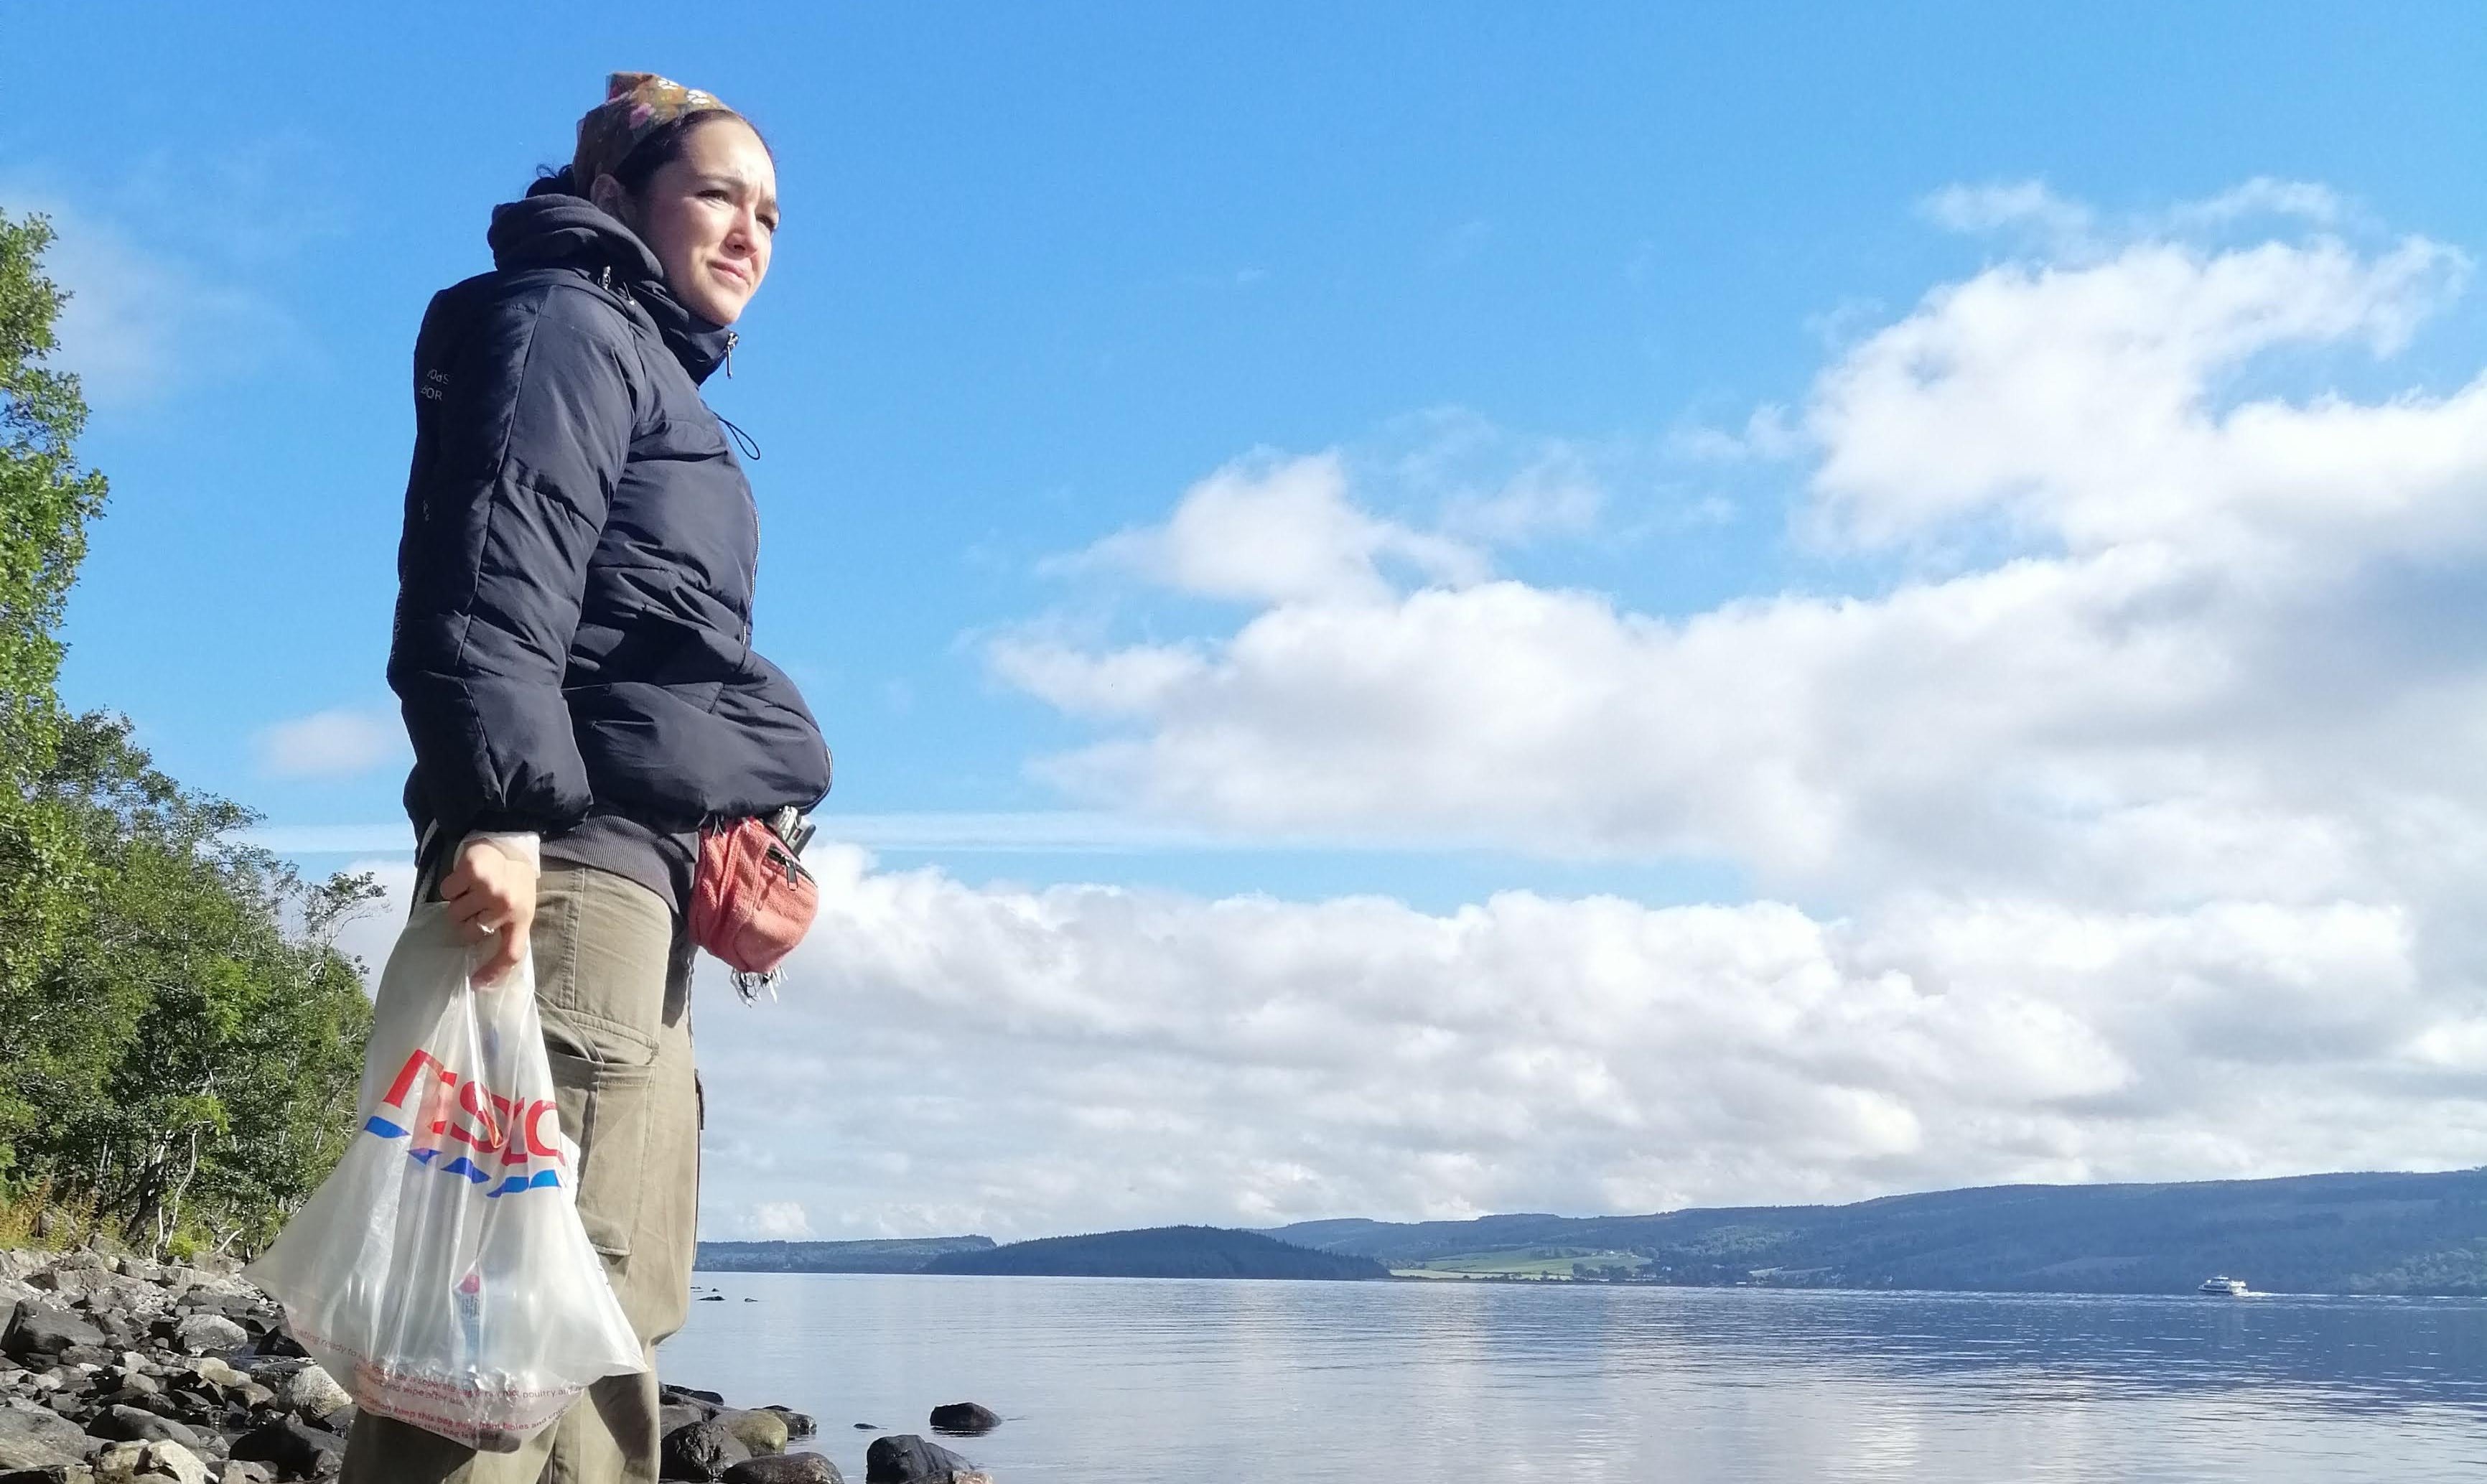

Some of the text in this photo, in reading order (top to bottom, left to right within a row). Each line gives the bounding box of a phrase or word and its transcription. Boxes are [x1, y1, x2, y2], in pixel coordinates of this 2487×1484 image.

[321, 1338, 346, 1354] ready
[347, 1347, 357, 1356] to
[403, 1386, 424, 1396] wipe
[426, 1390, 447, 1400] after
[418, 1378, 456, 1392] separate
[523, 1389, 556, 1399] poultry
[393, 1405, 416, 1418] keep
[418, 1411, 434, 1422] this
[437, 1416, 454, 1428] bag
[479, 1421, 500, 1430] from
[424, 1424, 441, 1432] this
[443, 1427, 459, 1438] bag
